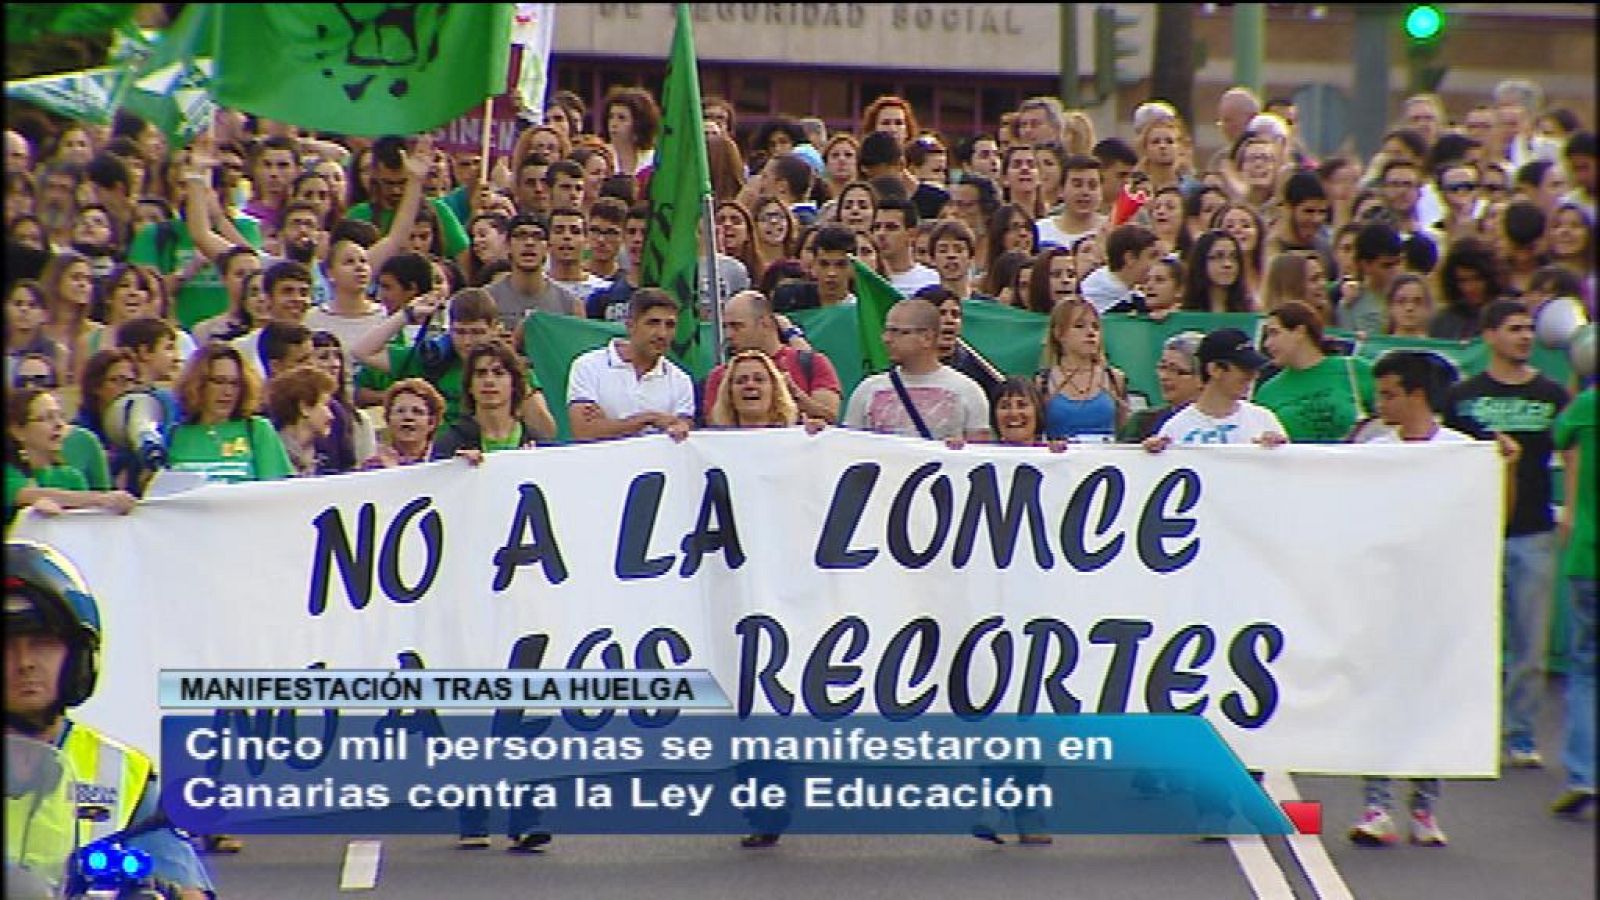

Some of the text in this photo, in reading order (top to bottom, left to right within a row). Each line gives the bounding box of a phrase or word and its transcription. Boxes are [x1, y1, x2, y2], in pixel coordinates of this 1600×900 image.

[668, 3, 865, 29] EGURIDAD
[891, 4, 1025, 35] SOCIAL
[308, 461, 1203, 616] NO A LA LOMCE
[490, 626, 692, 732] LOS
[734, 612, 1285, 729] RECORTES
